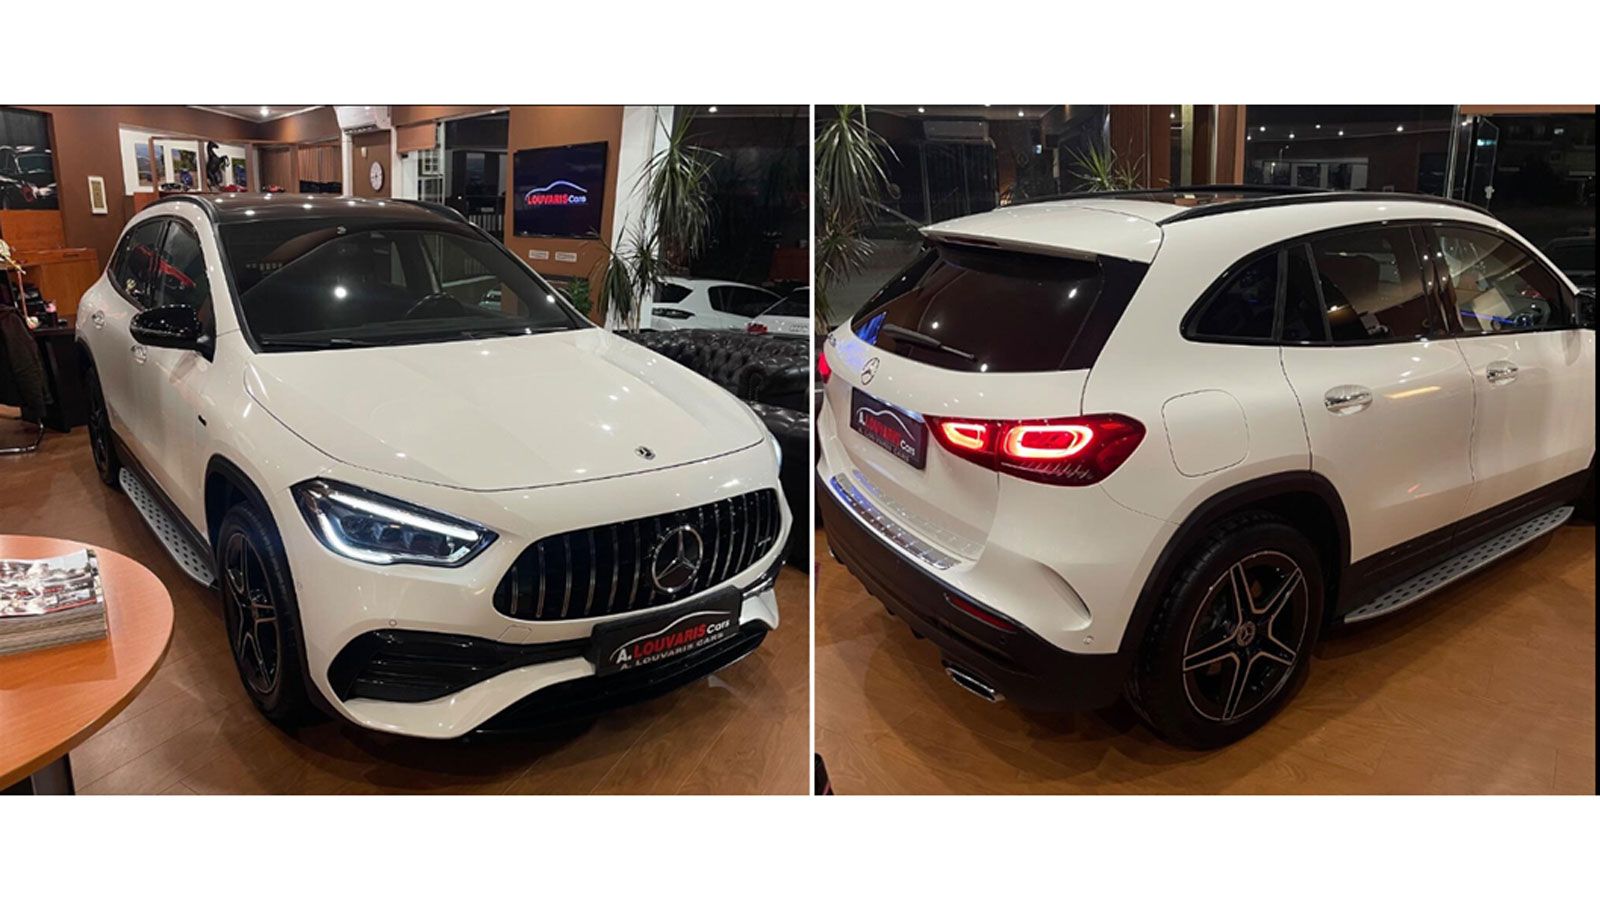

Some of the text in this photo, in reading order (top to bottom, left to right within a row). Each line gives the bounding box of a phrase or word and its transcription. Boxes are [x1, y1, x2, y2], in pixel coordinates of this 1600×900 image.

[616, 620, 730, 664] A. LOUVARIS Cars
[635, 644, 694, 666] LOUVARIS
[697, 632, 724, 647] CARS
